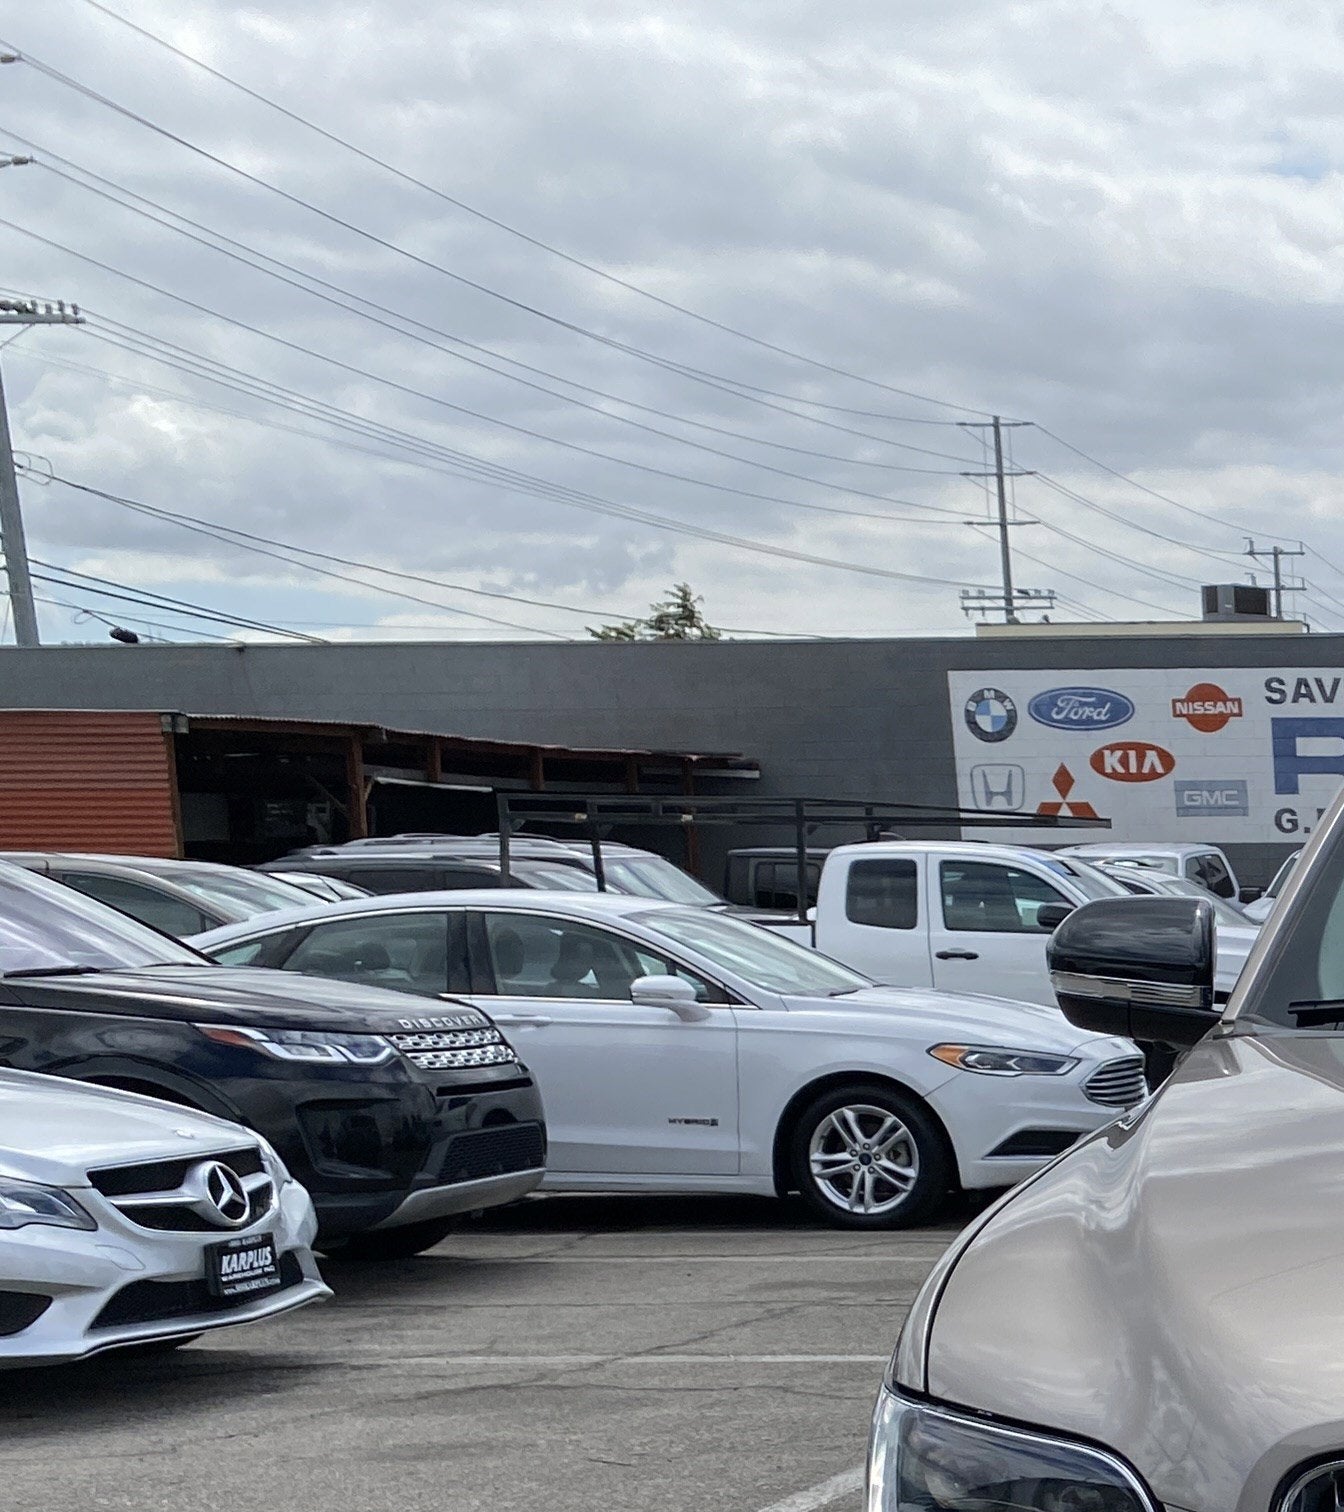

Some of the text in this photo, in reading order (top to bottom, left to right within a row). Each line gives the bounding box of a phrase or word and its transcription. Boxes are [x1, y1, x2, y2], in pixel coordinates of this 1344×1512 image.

[1051, 695, 1110, 721] Ford
[1176, 701, 1239, 715] NISSAN
[1103, 750, 1164, 774] KIA
[1184, 790, 1239, 806] GMC
[221, 1246, 272, 1274] KARPLUS
